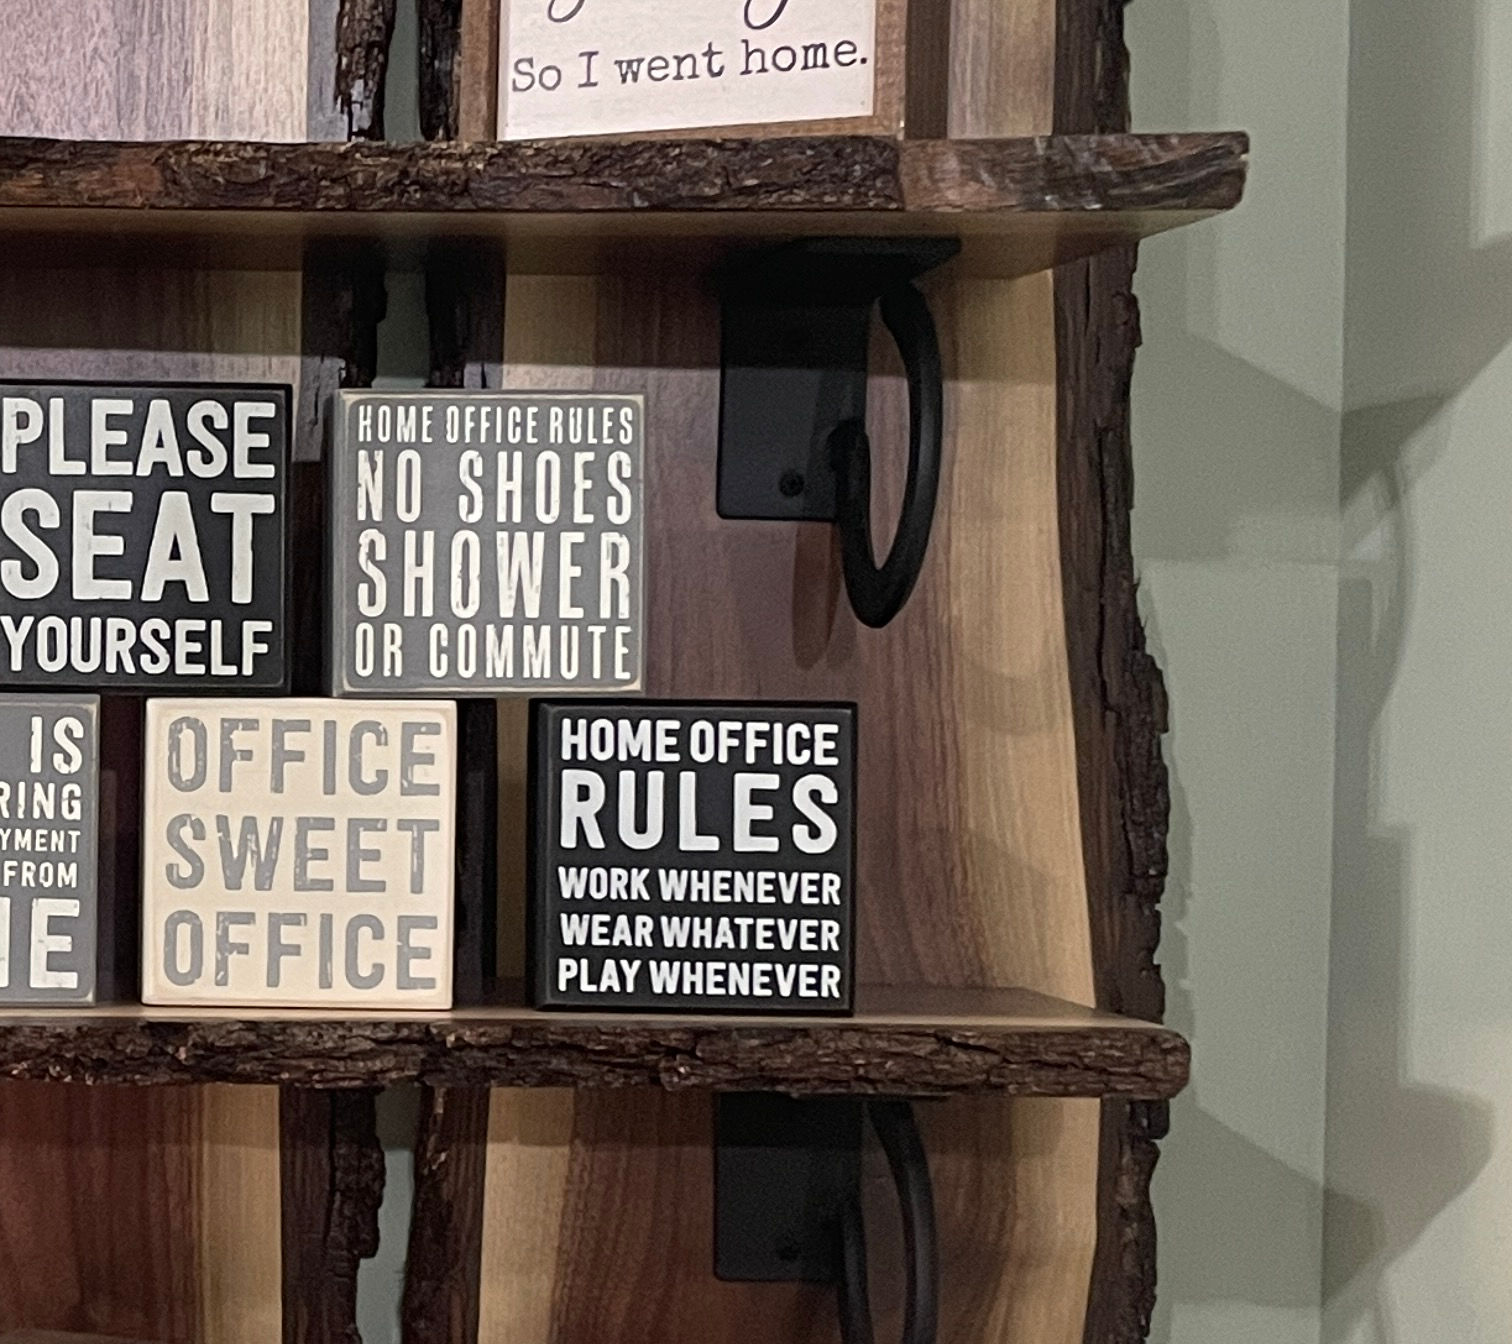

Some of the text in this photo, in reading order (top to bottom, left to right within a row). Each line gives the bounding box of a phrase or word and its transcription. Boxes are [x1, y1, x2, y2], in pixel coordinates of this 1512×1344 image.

[512, 39, 868, 92] So I went home.
[1, 396, 276, 479] PLEASE
[358, 406, 632, 444] HOME OFFICE RULES
[357, 449, 632, 524] NO SHOES
[0, 488, 275, 603] SEAT
[358, 528, 630, 619] SHOWER
[0, 614, 273, 677] YOURSELF
[356, 622, 631, 679] OR COMMUTE
[30, 716, 84, 774] IS
[168, 716, 441, 796] OFFICE
[561, 718, 839, 766] HOME OFFICE
[560, 769, 838, 854] RULES
[3, 861, 77, 888] FROM
[165, 813, 440, 894] SWEET
[558, 866, 841, 905] WORK WHENEVER
[164, 910, 438, 990] OFFICE
[560, 913, 840, 951] WEAR WHATEVER
[558, 958, 840, 998] PLAY WHENEVER
